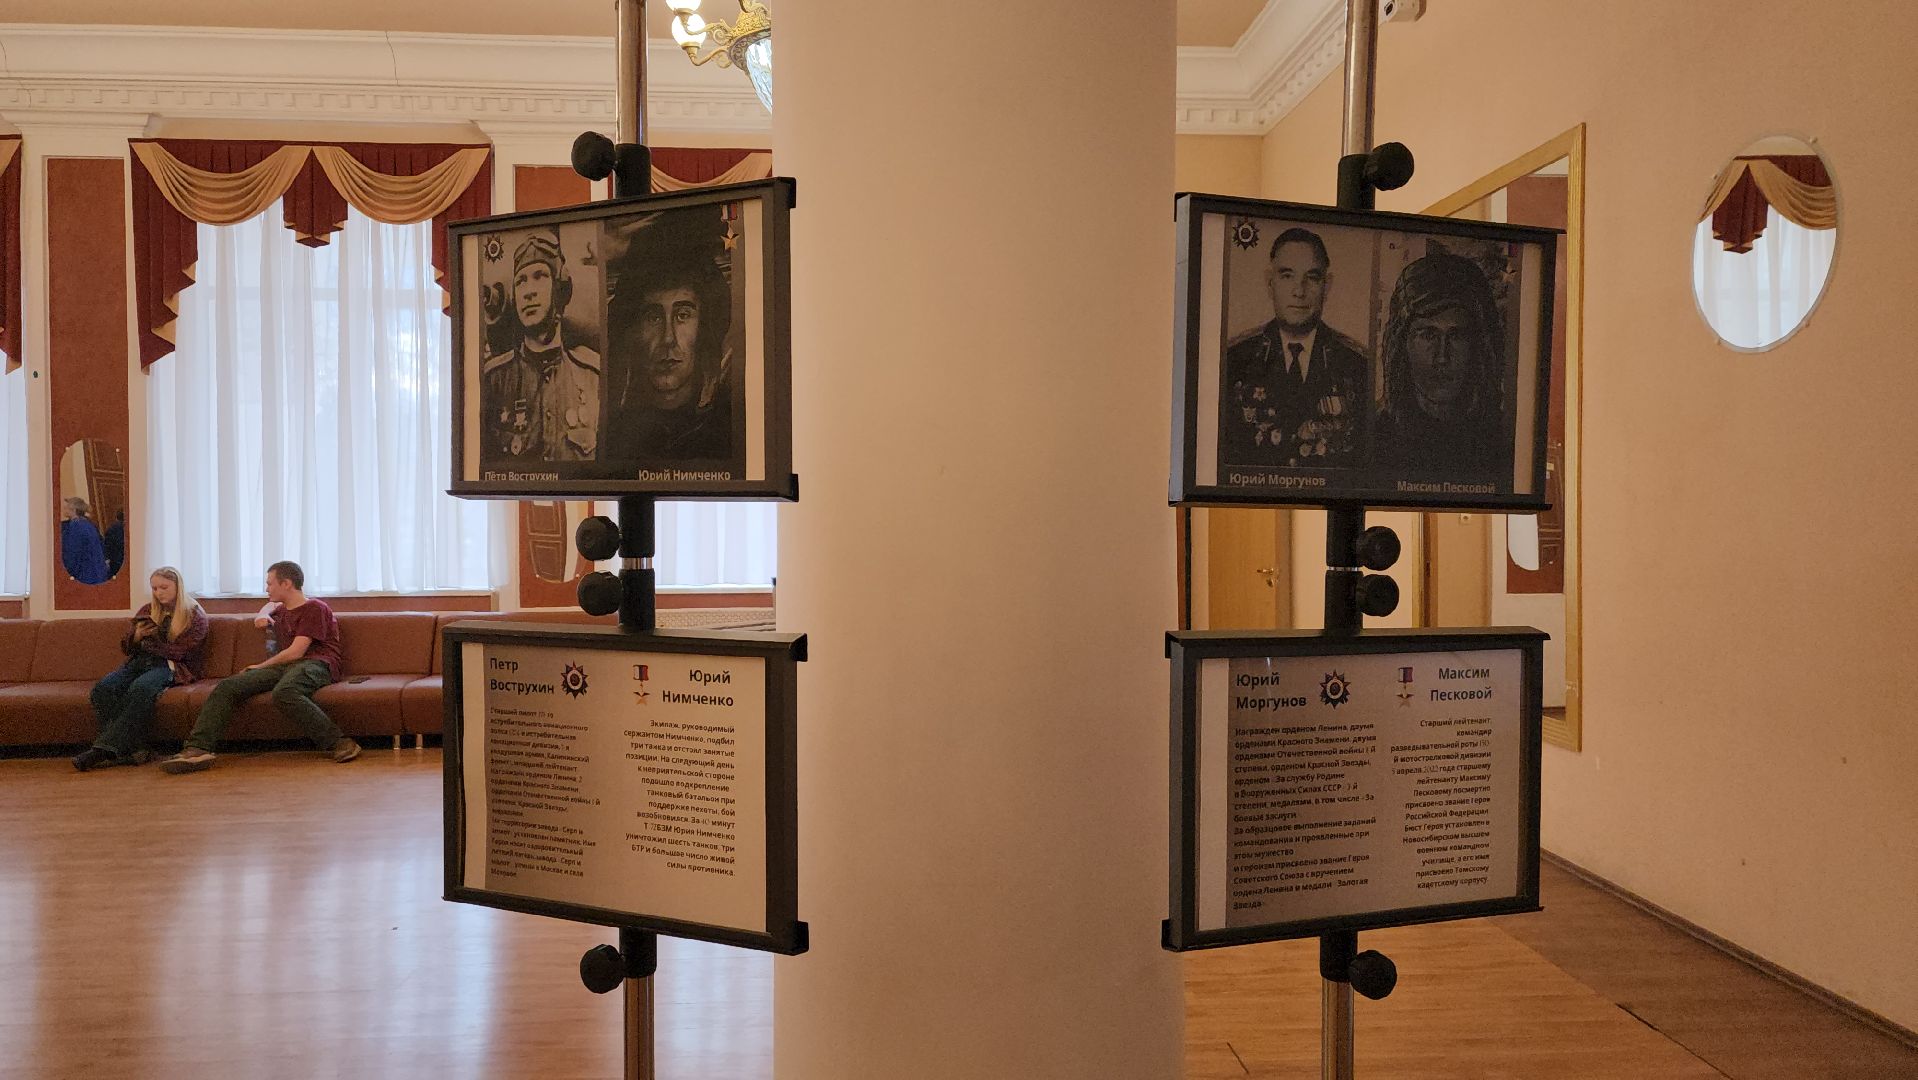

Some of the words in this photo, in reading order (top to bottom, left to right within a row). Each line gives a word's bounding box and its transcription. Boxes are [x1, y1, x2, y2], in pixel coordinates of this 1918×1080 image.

[639, 470, 670, 480] Юрий
[674, 471, 730, 480] Нимченко
[1230, 473, 1265, 485] Юрий
[1269, 475, 1325, 488] Моргунов
[1398, 482, 1440, 492] Максим
[1443, 482, 1496, 493] Песковой
[490, 658, 518, 673] Петр
[690, 670, 731, 686] Юрий
[1439, 667, 1489, 679] Максим
[1237, 672, 1280, 689] Юрий
[490, 679, 554, 695] Вострухин
[663, 690, 734, 706] Нимченко
[1431, 689, 1492, 701] Песковой
[1237, 695, 1307, 712] Моргунов
[682, 723, 734, 733] руководимый
[1420, 718, 1452, 727] Старший
[1282, 726, 1316, 734] орденом
[1457, 729, 1492, 737] командир
[624, 730, 664, 739] сержантом
[666, 733, 705, 743] Нимченко,
[707, 737, 735, 746] подбил
[1278, 738, 1313, 746] Красного
[631, 742, 643, 750] три
[674, 746, 701, 754] отстоял
[703, 749, 734, 757] занятые
[1391, 742, 1459, 753] разведывательной
[1461, 741, 1478, 749] роты
[1277, 748, 1338, 758] Отечественной
[1400, 753, 1459, 763] мотострелковой
[672, 758, 715, 767] следующий
[717, 761, 734, 769] день
[1308, 761, 1339, 769] Красной
[643, 766, 703, 777] неприятельской
[705, 772, 734, 780] стороне
[1397, 768, 1421, 776] апреля
[1457, 763, 1491, 771] старшему
[642, 777, 674, 786] подошло
[1287, 774, 1314, 783] службу
[1417, 776, 1458, 785] лейтенанту
[1460, 774, 1491, 782] Максиму
[647, 788, 683, 799] танковый
[685, 793, 719, 802] батальон
[721, 797, 735, 805] при
[1414, 788, 1452, 797] Песковому
[1453, 786, 1491, 794] посмертно
[649, 801, 689, 810] поддержке
[1406, 800, 1443, 809] присвоено
[1472, 797, 1490, 805] Героя
[1406, 810, 1447, 820] Российской
[711, 821, 735, 829] минут
[1245, 824, 1291, 836] образцовое
[1294, 821, 1342, 831] выполнение
[1344, 818, 1376, 826] заданий
[1424, 823, 1443, 831] Героя
[1444, 821, 1484, 830] установлен
[674, 826, 694, 835] Юрия
[697, 830, 735, 840] Нимченко
[626, 833, 666, 844] уничтожил
[722, 845, 735, 853] три
[1234, 837, 1293, 847] командования
[1302, 832, 1354, 843] проявленные
[1403, 834, 1459, 844] Новосибирском
[632, 844, 644, 852] БТР
[652, 847, 684, 857] большое
[686, 852, 708, 860] число
[710, 856, 735, 864] живой
[1254, 848, 1294, 859] мужество
[1417, 846, 1448, 854] военном
[1450, 843, 1489, 851] командном
[1319, 857, 1347, 865] звание
[667, 861, 686, 869] силы
[688, 865, 735, 876] противника.
[1416, 868, 1453, 879] присвоено
[1455, 866, 1489, 874] Томскому
[1234, 874, 1278, 885] Советского
[1280, 872, 1304, 880] Союза
[1311, 868, 1354, 879] вручением
[1263, 886, 1293, 894] Ленина
[1418, 879, 1458, 890] кадетскому
